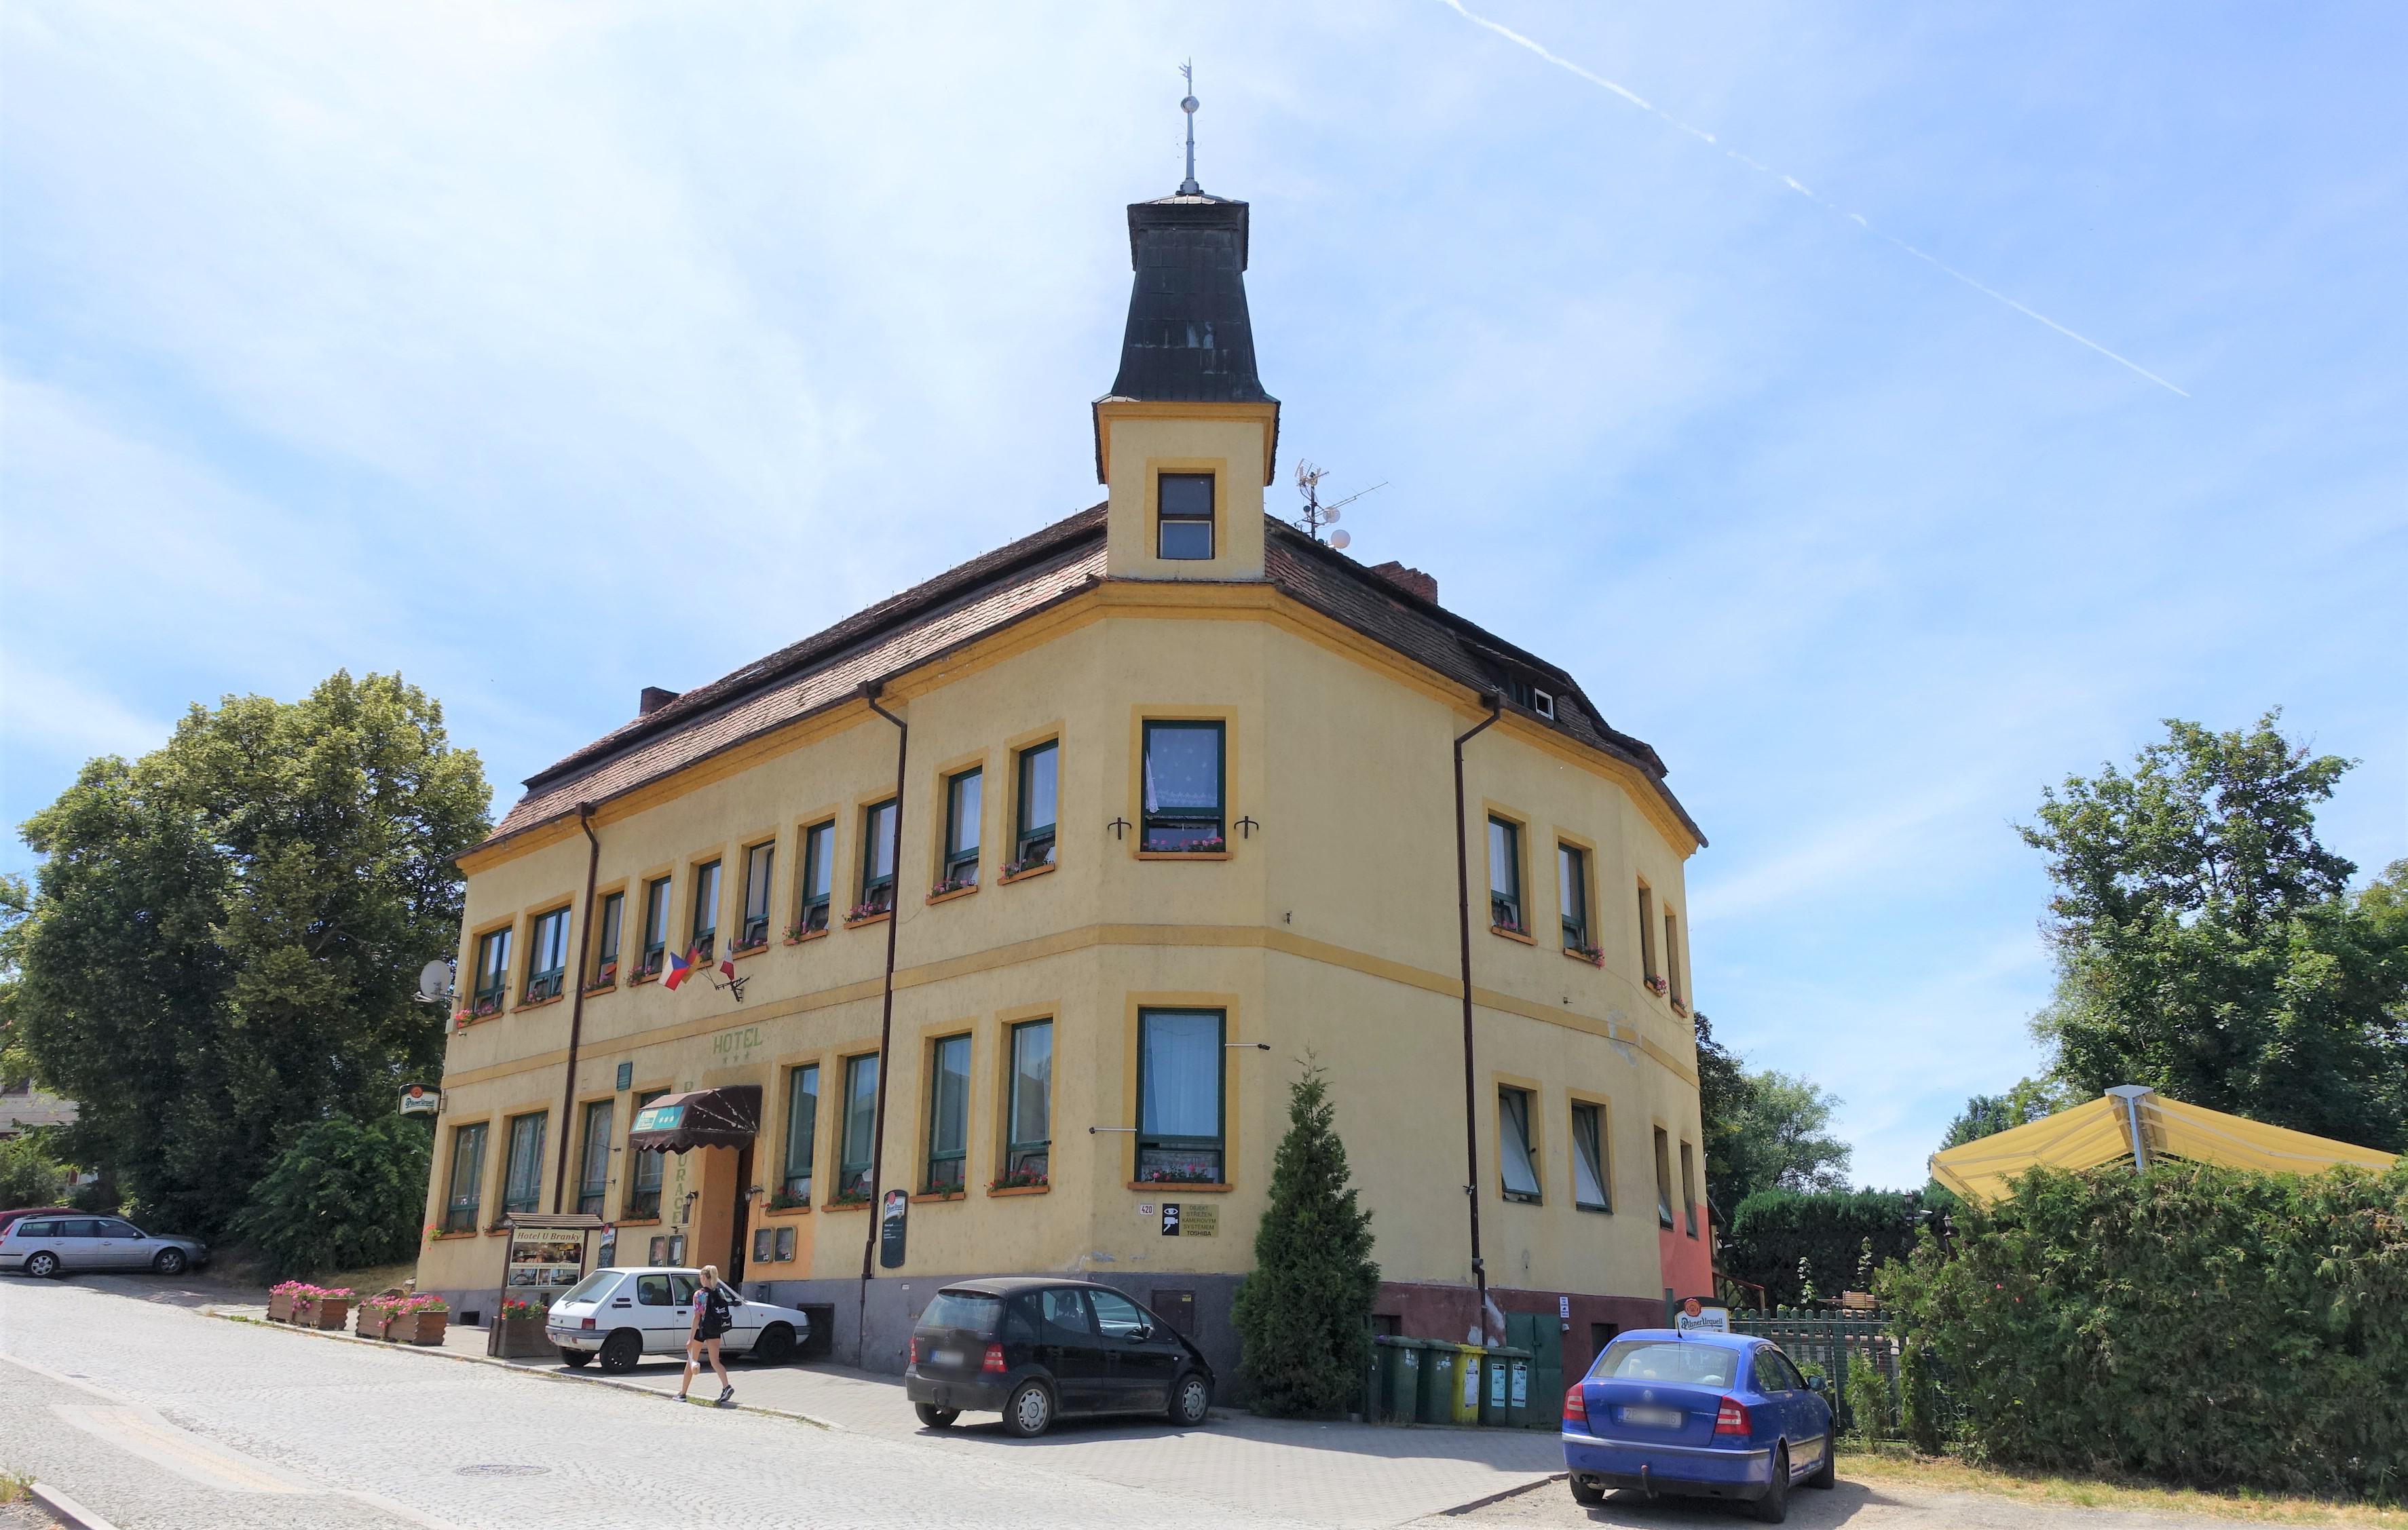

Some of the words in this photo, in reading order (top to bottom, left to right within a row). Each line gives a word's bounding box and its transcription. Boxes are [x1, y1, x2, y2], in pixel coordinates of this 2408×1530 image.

[713, 1027, 762, 1054] HOTEL
[550, 1233, 581, 1242] Branky
[1681, 1317, 1702, 1330] Pilsner
[1701, 1318, 1723, 1328] Urquell
